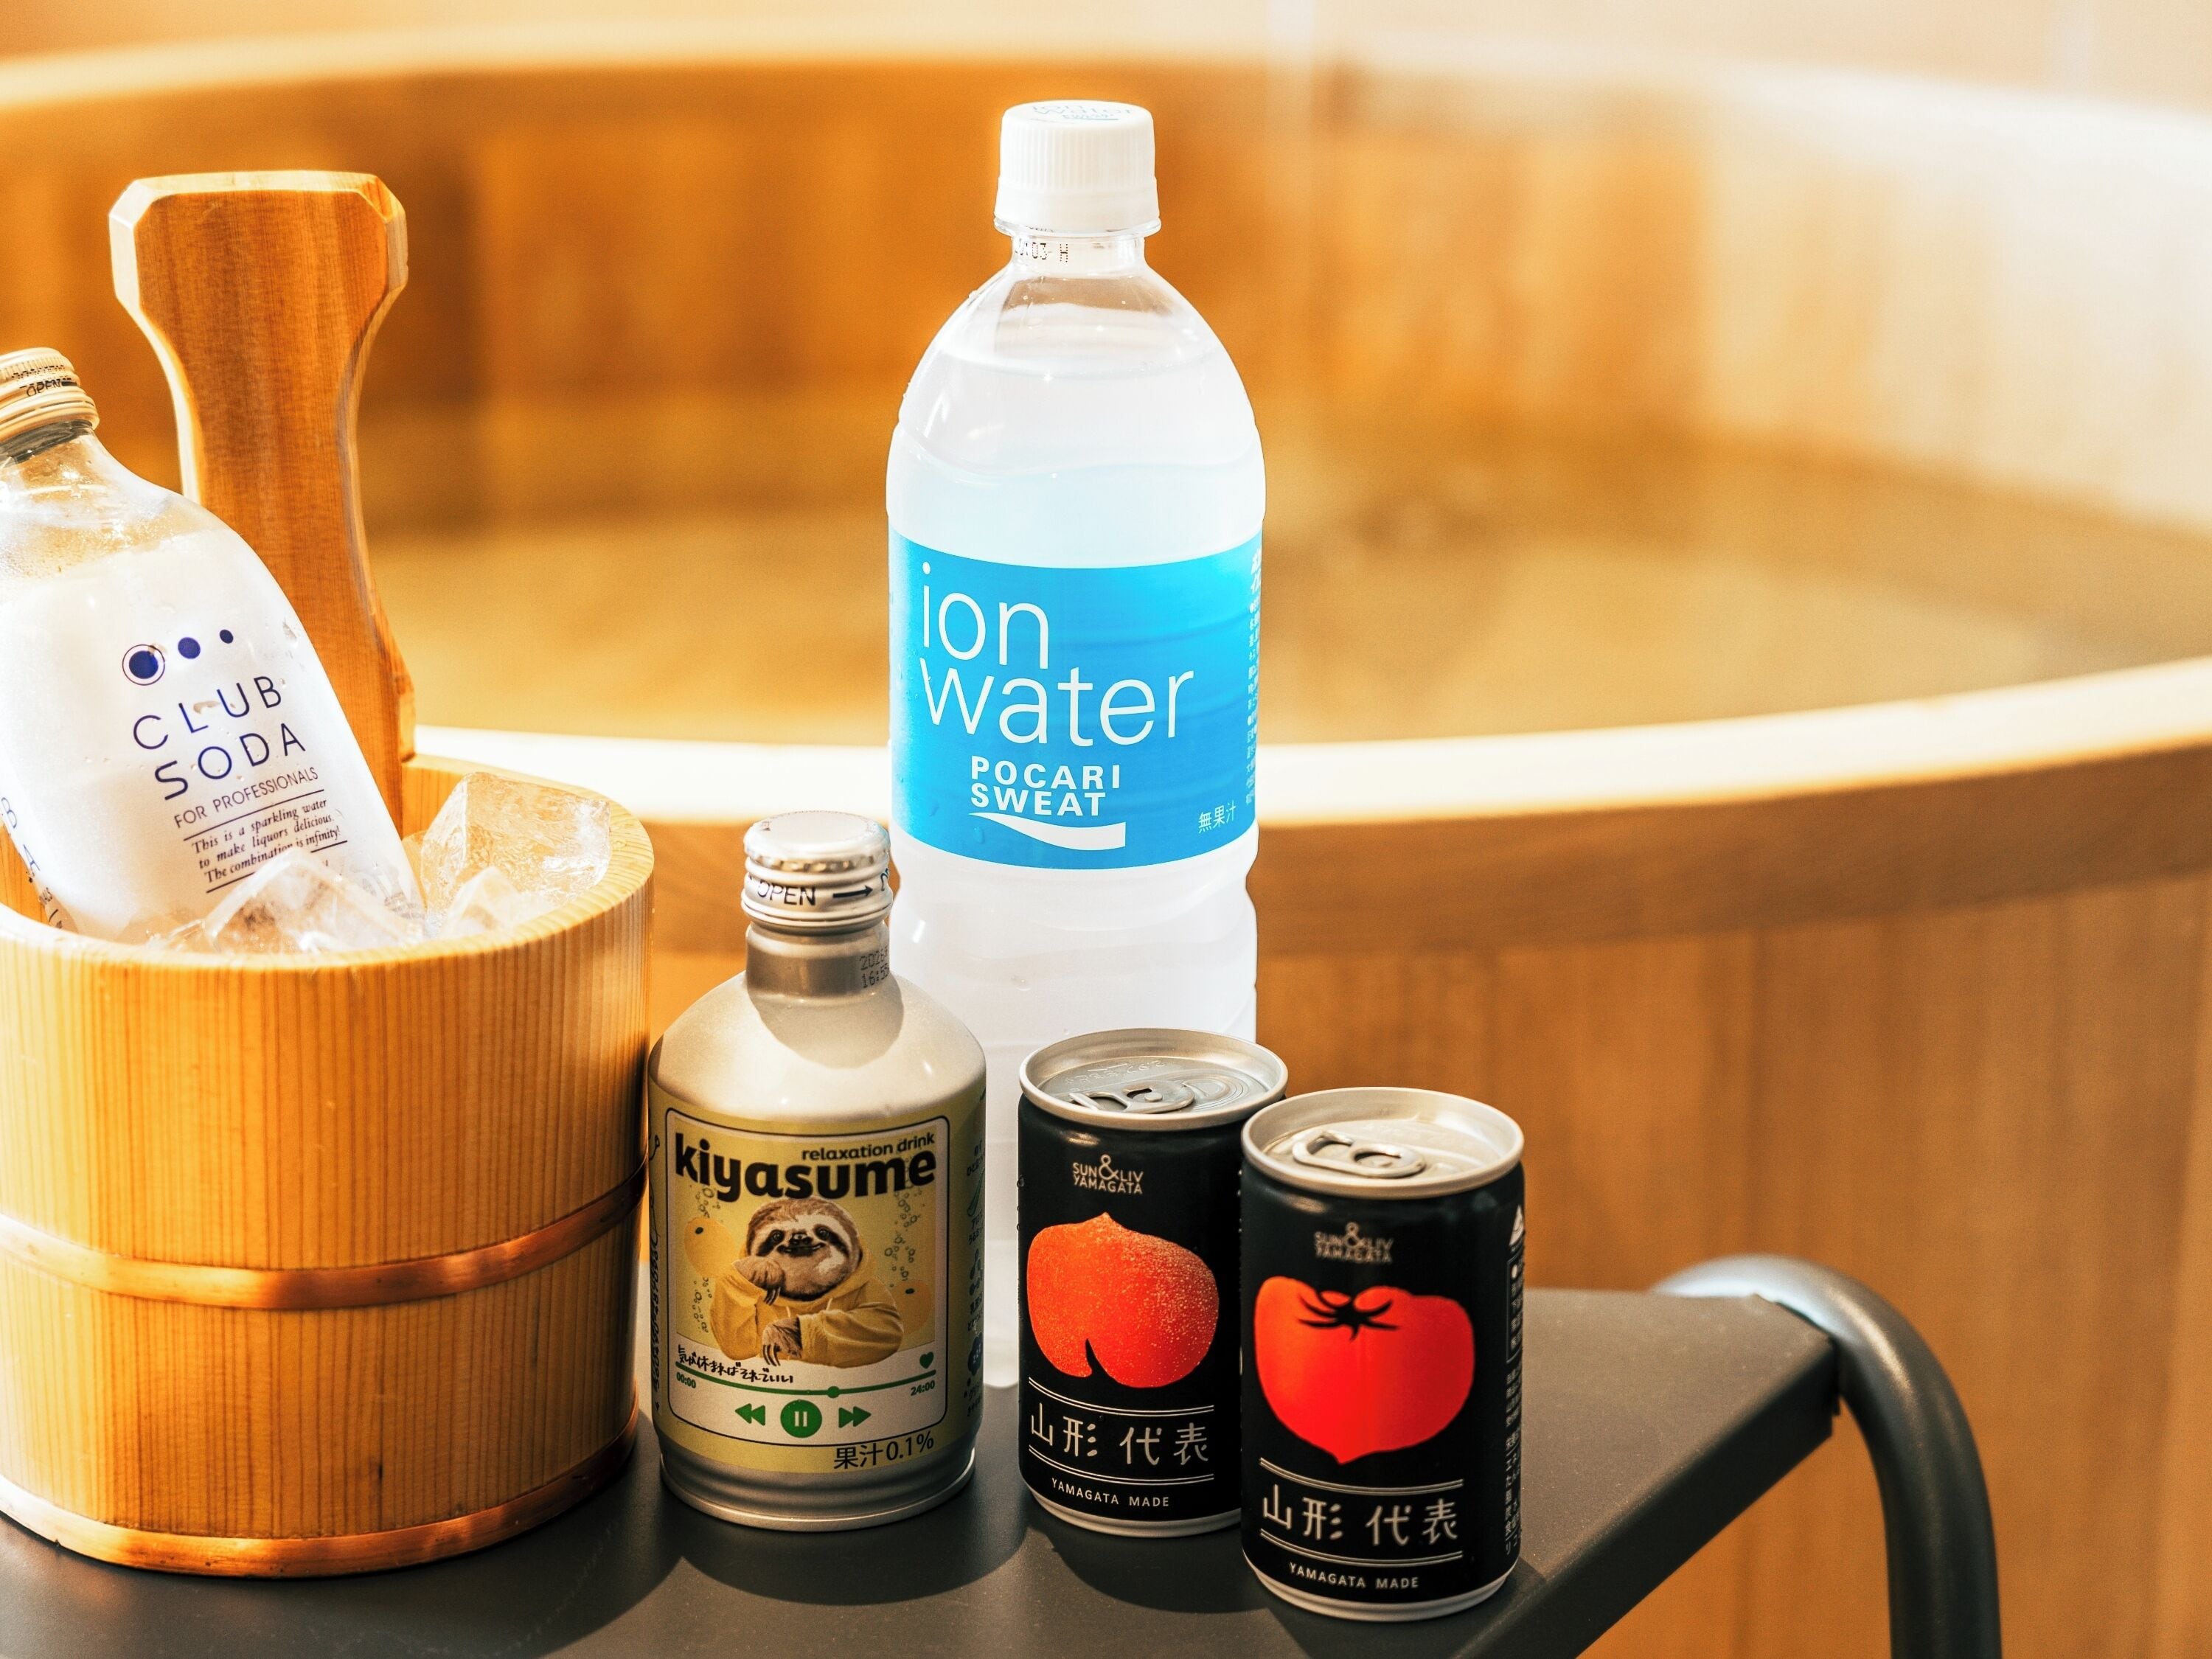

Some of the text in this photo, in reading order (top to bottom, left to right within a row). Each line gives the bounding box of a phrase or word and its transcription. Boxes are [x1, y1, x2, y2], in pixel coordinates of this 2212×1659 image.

[922, 561, 1048, 669] ion
[133, 676, 282, 750] CLUB
[920, 658, 1194, 747] water
[155, 723, 306, 801] SODA
[971, 756, 1120, 790] POCARI
[173, 767, 319, 829] FOR PROFESSIONALS
[971, 782, 1105, 816] SWEAT
[192, 799, 327, 854] This is a sparkling water
[1198, 800, 1237, 834] 無果汁
[199, 857, 210, 869] to
[217, 844, 246, 861] make
[252, 829, 288, 848] liquors
[204, 866, 228, 884] The
[296, 838, 305, 848] is
[306, 825, 341, 846] infinity!
[757, 880, 816, 906] OPEN
[801, 1132, 935, 1161] relaxation drink
[675, 1133, 936, 1203] kiyasume
[1074, 1173, 1143, 1194] YAMAGATA
[676, 1372, 697, 1389] 00:00
[910, 1380, 936, 1396] 24:00
[834, 1431, 934, 1470] 果汁0.1%
[1051, 1477, 1169, 1507] YAMAGATA MADE
[1290, 1562, 1419, 1589] YAMAGATA MADE
